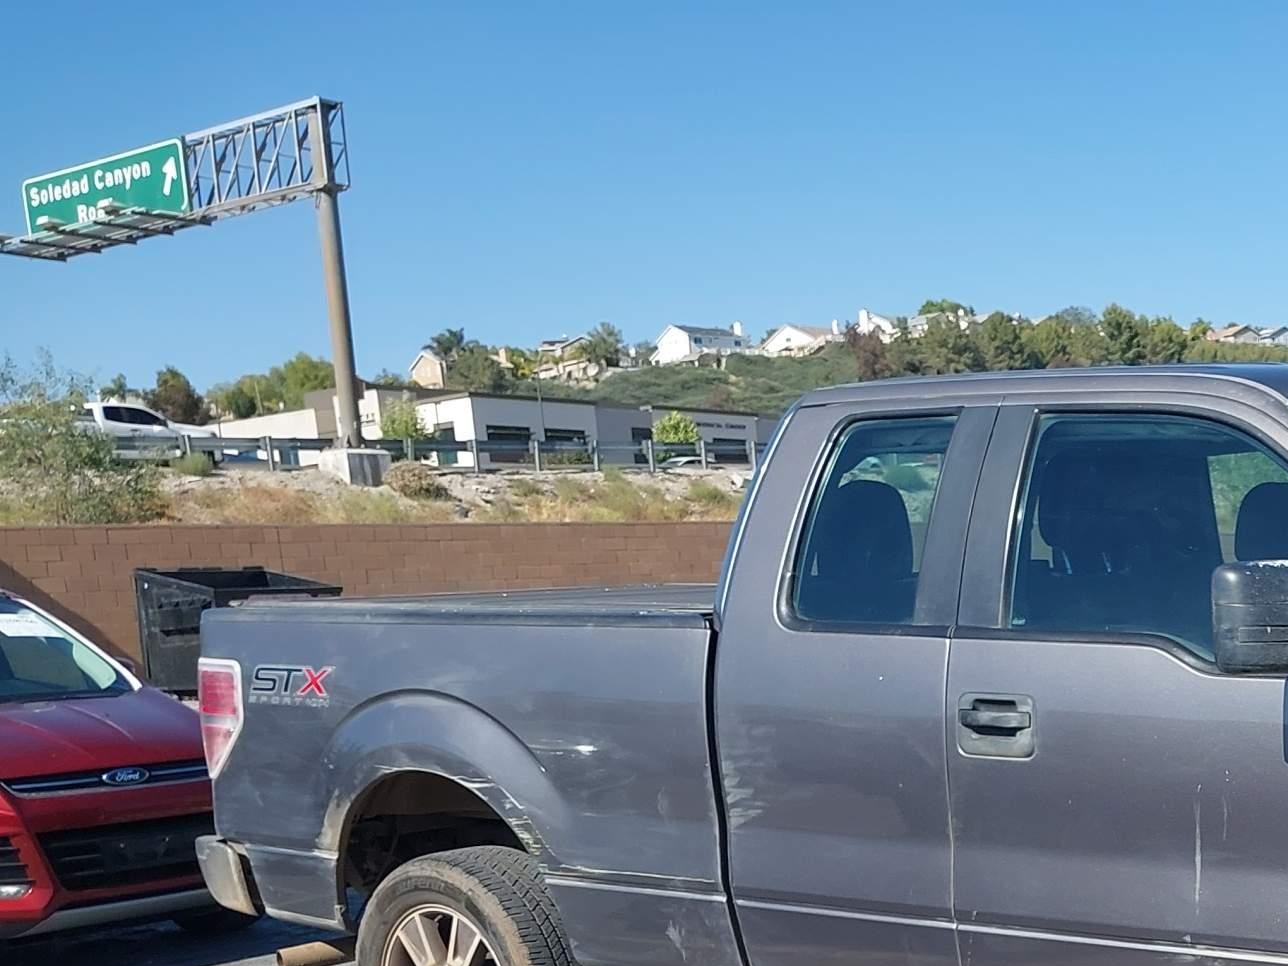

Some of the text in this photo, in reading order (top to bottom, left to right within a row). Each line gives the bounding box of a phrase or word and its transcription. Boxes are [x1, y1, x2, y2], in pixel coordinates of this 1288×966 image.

[30, 160, 152, 207] Soledad Canyon
[77, 203, 108, 224] Roa
[249, 664, 336, 697] STX
